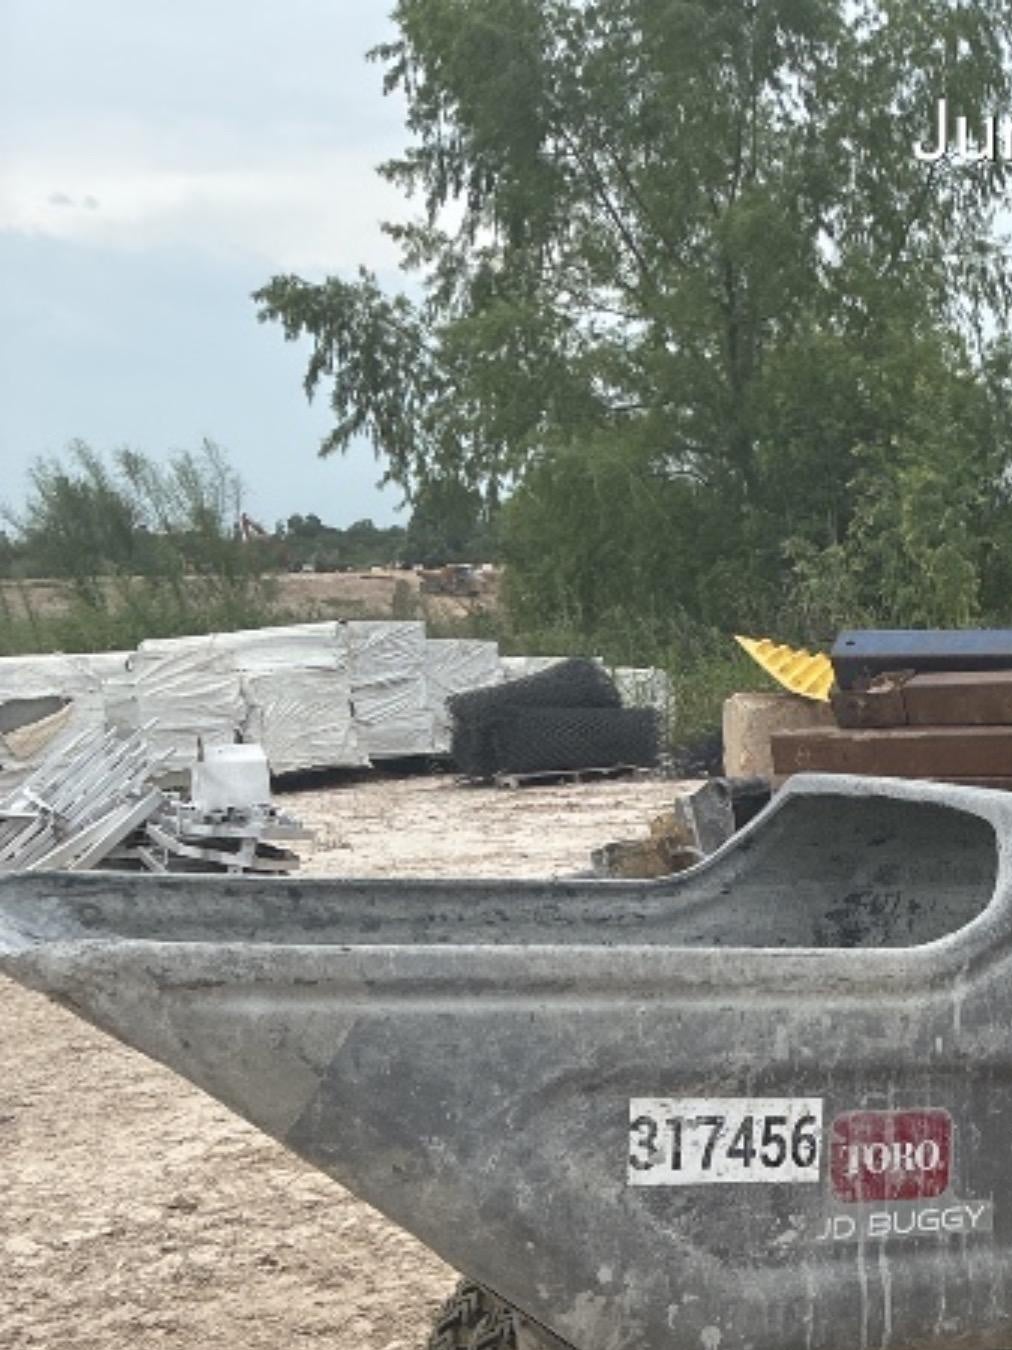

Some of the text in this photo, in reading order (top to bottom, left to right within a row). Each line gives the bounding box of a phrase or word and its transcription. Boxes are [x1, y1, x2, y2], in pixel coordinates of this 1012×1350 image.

[629, 1115, 817, 1171] 317456
[840, 1139, 941, 1177] TORO
[868, 1205, 984, 1237] BUGGY
